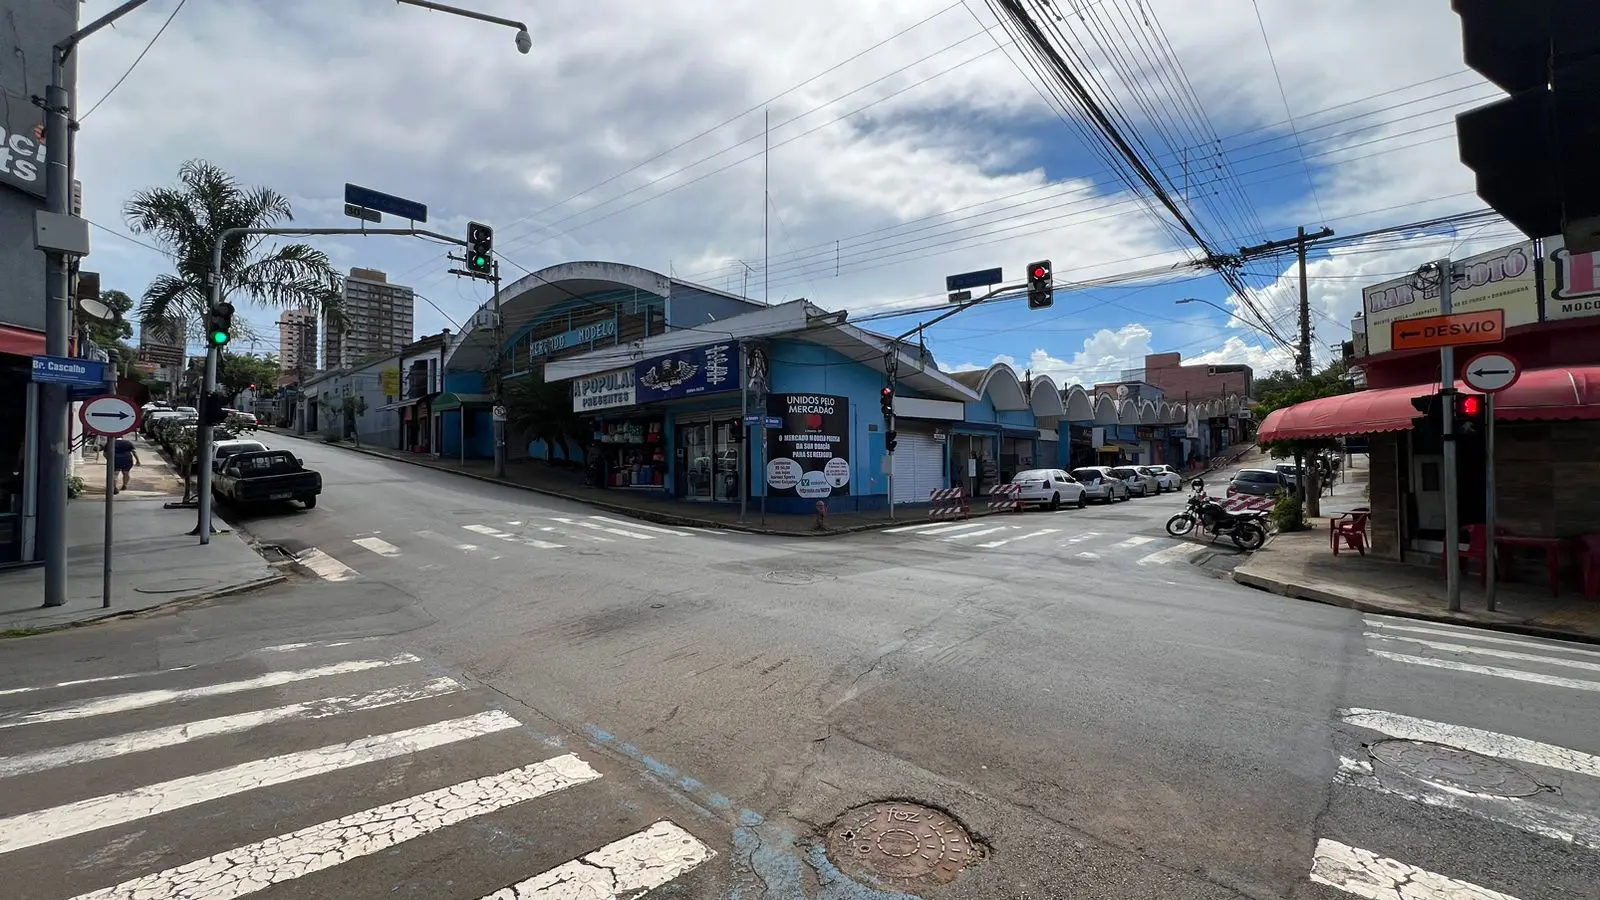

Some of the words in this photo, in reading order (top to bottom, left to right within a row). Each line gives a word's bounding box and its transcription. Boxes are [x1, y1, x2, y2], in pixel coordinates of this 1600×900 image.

[1371, 285, 1414, 312] BAR
[577, 321, 614, 342] MODELO
[1424, 319, 1496, 338] DESVIO
[48, 361, 86, 374] Cascalho
[575, 381, 581, 396] A
[582, 391, 629, 407] PRESENTES
[786, 396, 819, 405] UNIDOS
[820, 397, 835, 406] PELO
[887, 806, 921, 823] foz
